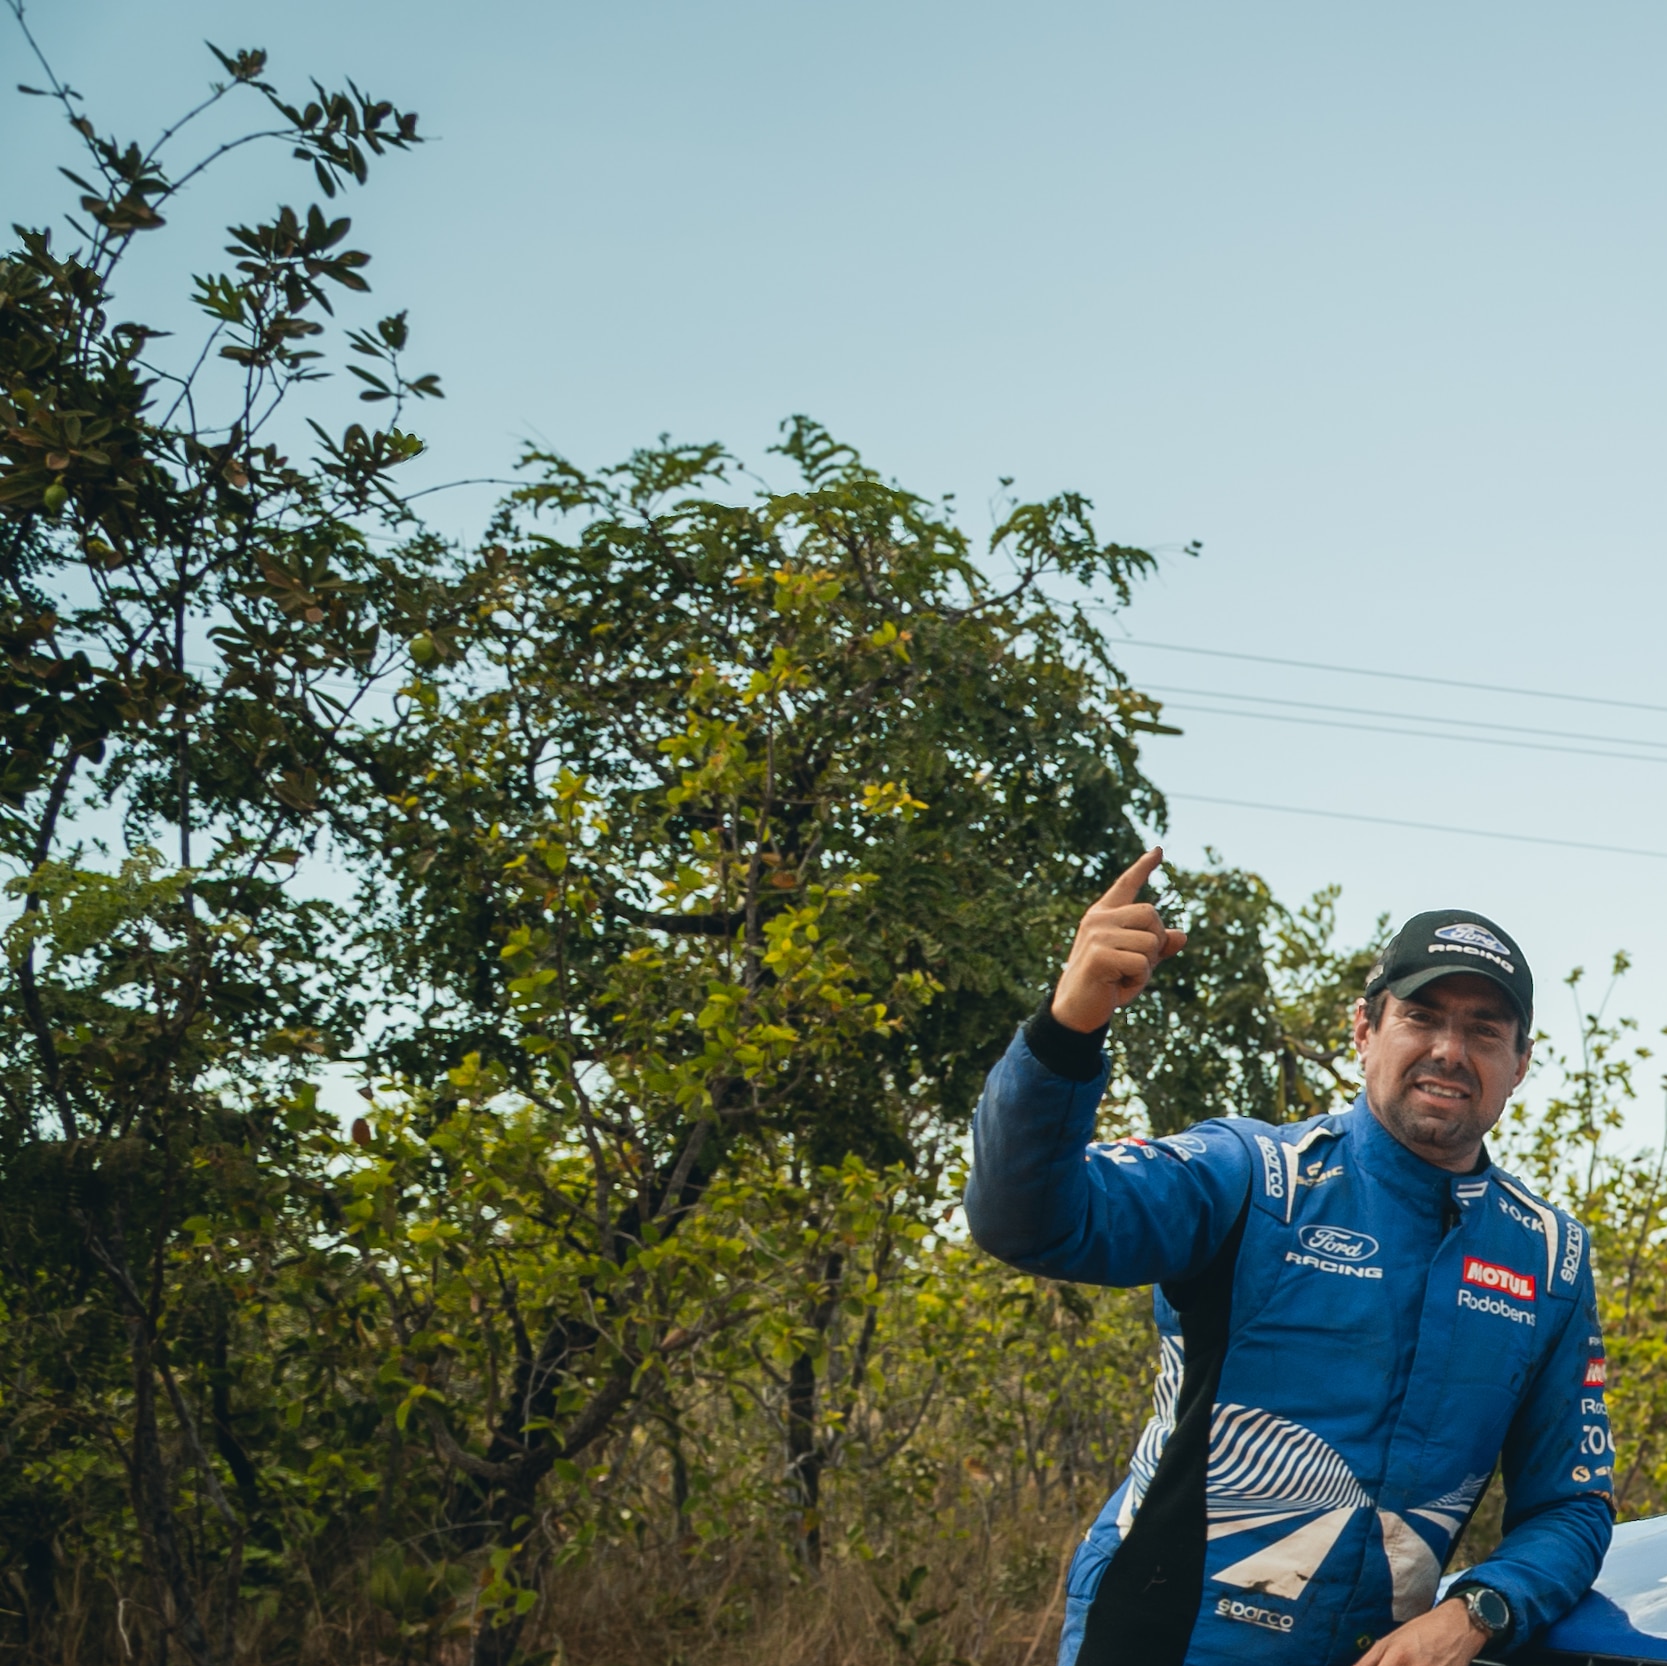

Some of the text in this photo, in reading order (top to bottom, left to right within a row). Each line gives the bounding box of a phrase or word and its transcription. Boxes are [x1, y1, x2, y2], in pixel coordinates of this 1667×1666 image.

[1451, 927, 1498, 949] Ford
[1428, 944, 1514, 973] RACING
[1256, 1134, 1283, 1198] sparco
[1309, 1229, 1363, 1257] Ford
[1560, 1222, 1583, 1285] sparco
[1285, 1252, 1383, 1279] RACING
[1466, 1262, 1532, 1297] MOTUL
[1458, 1289, 1536, 1326] Rodobens
[1214, 1599, 1294, 1632] sparco
